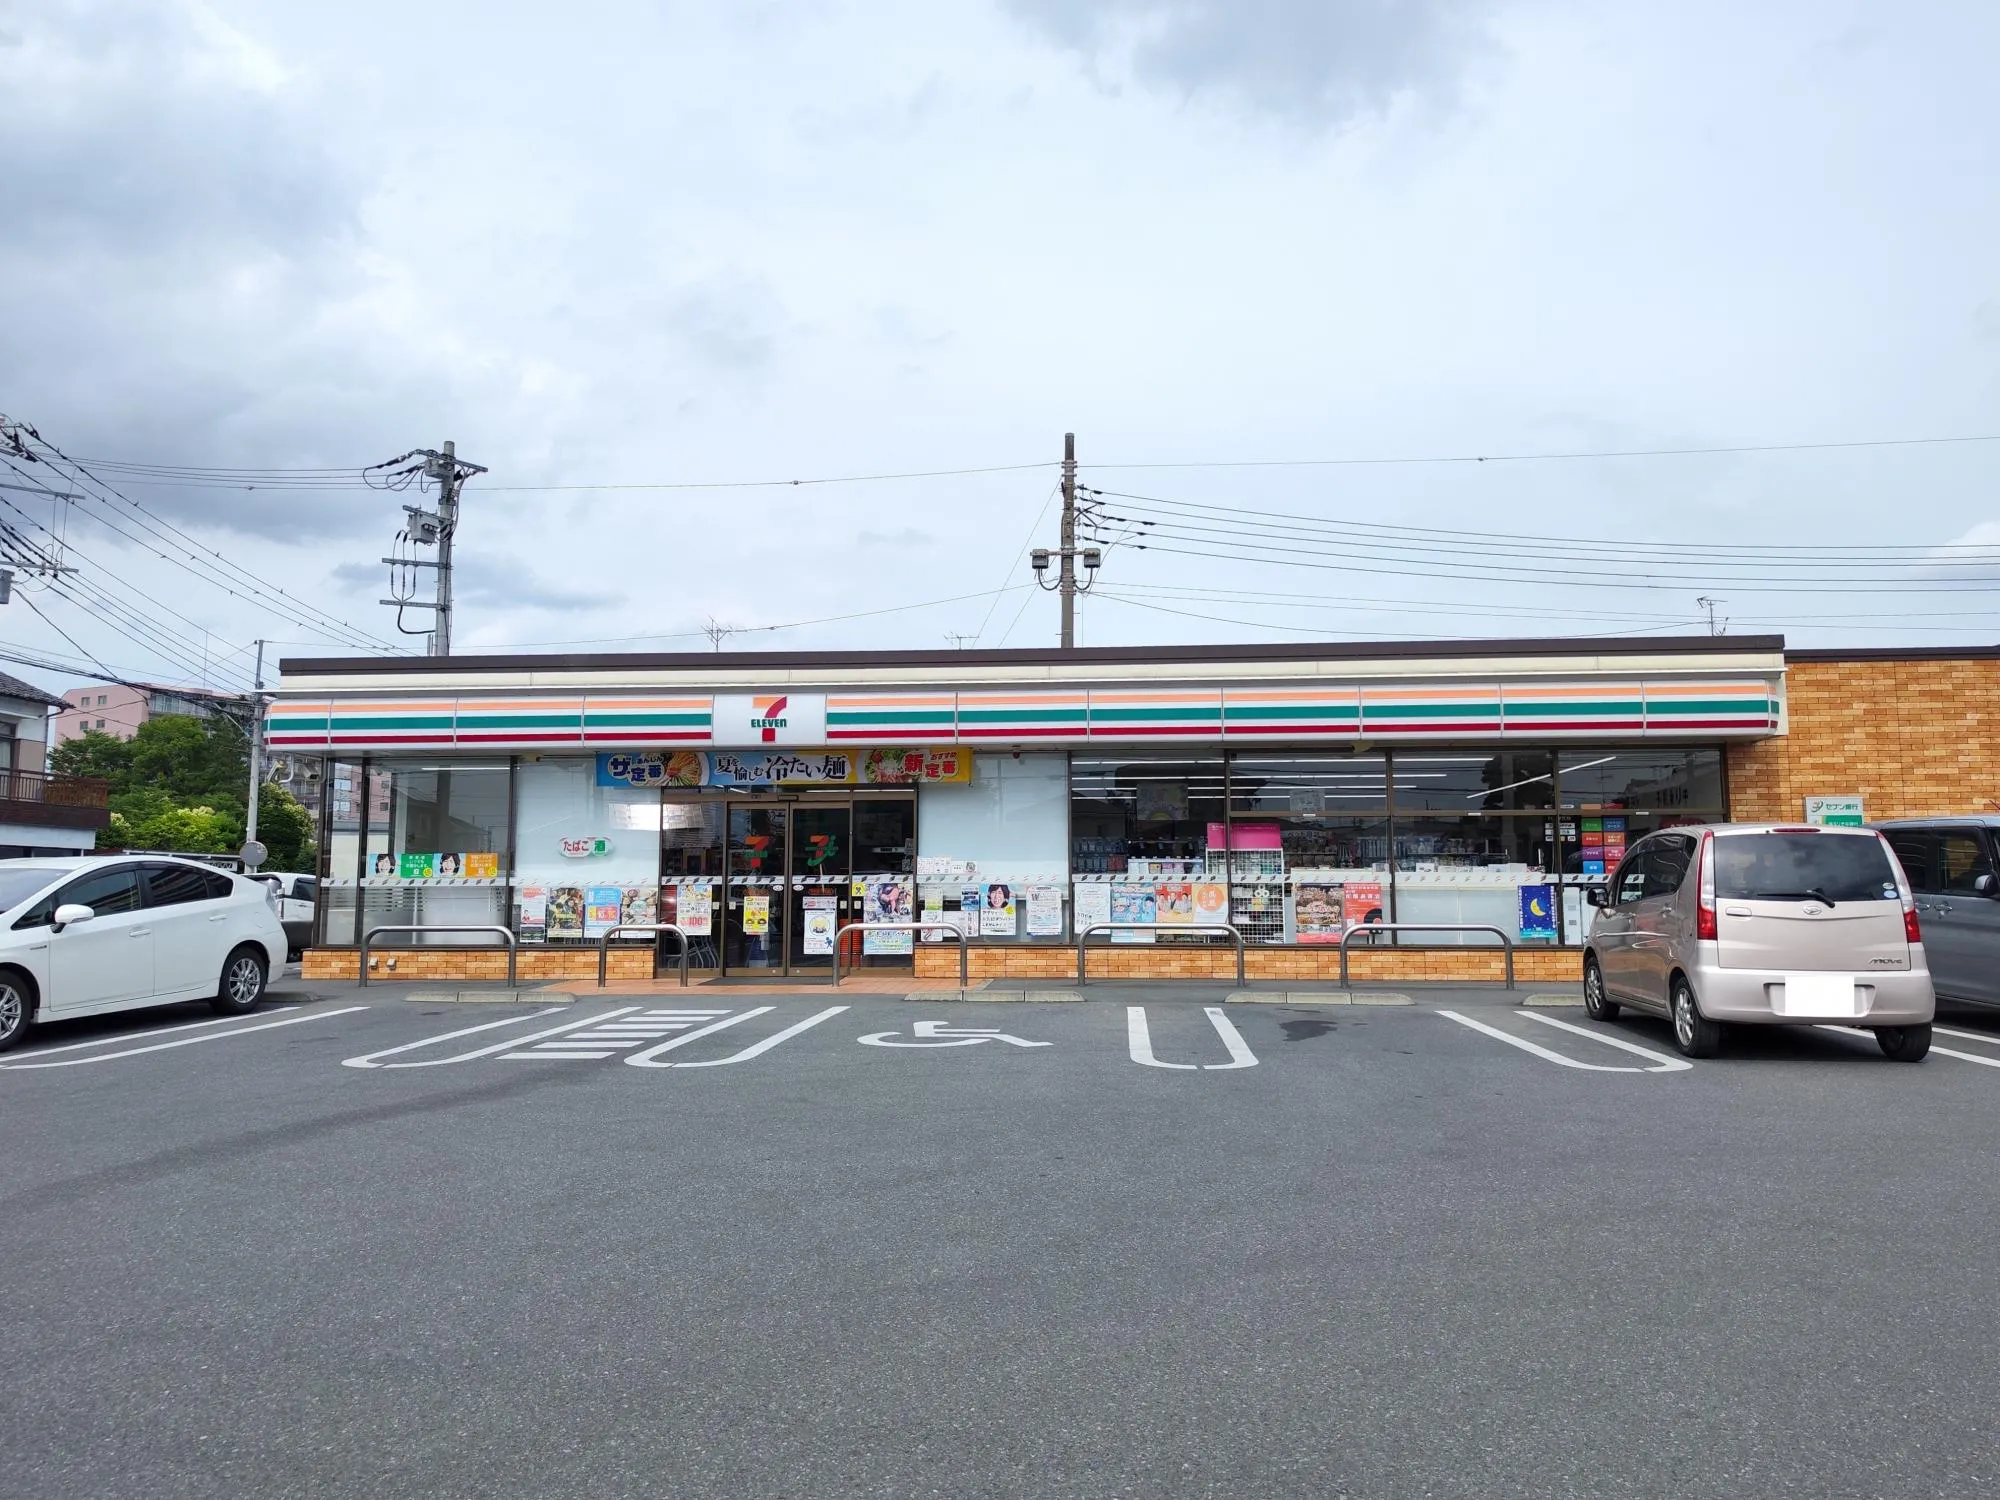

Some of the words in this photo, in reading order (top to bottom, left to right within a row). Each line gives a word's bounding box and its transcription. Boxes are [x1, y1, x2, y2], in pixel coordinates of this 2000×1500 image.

[752, 696, 787, 742] 7
[904, 753, 956, 778] 新定番
[563, 840, 589, 851] たばこ
